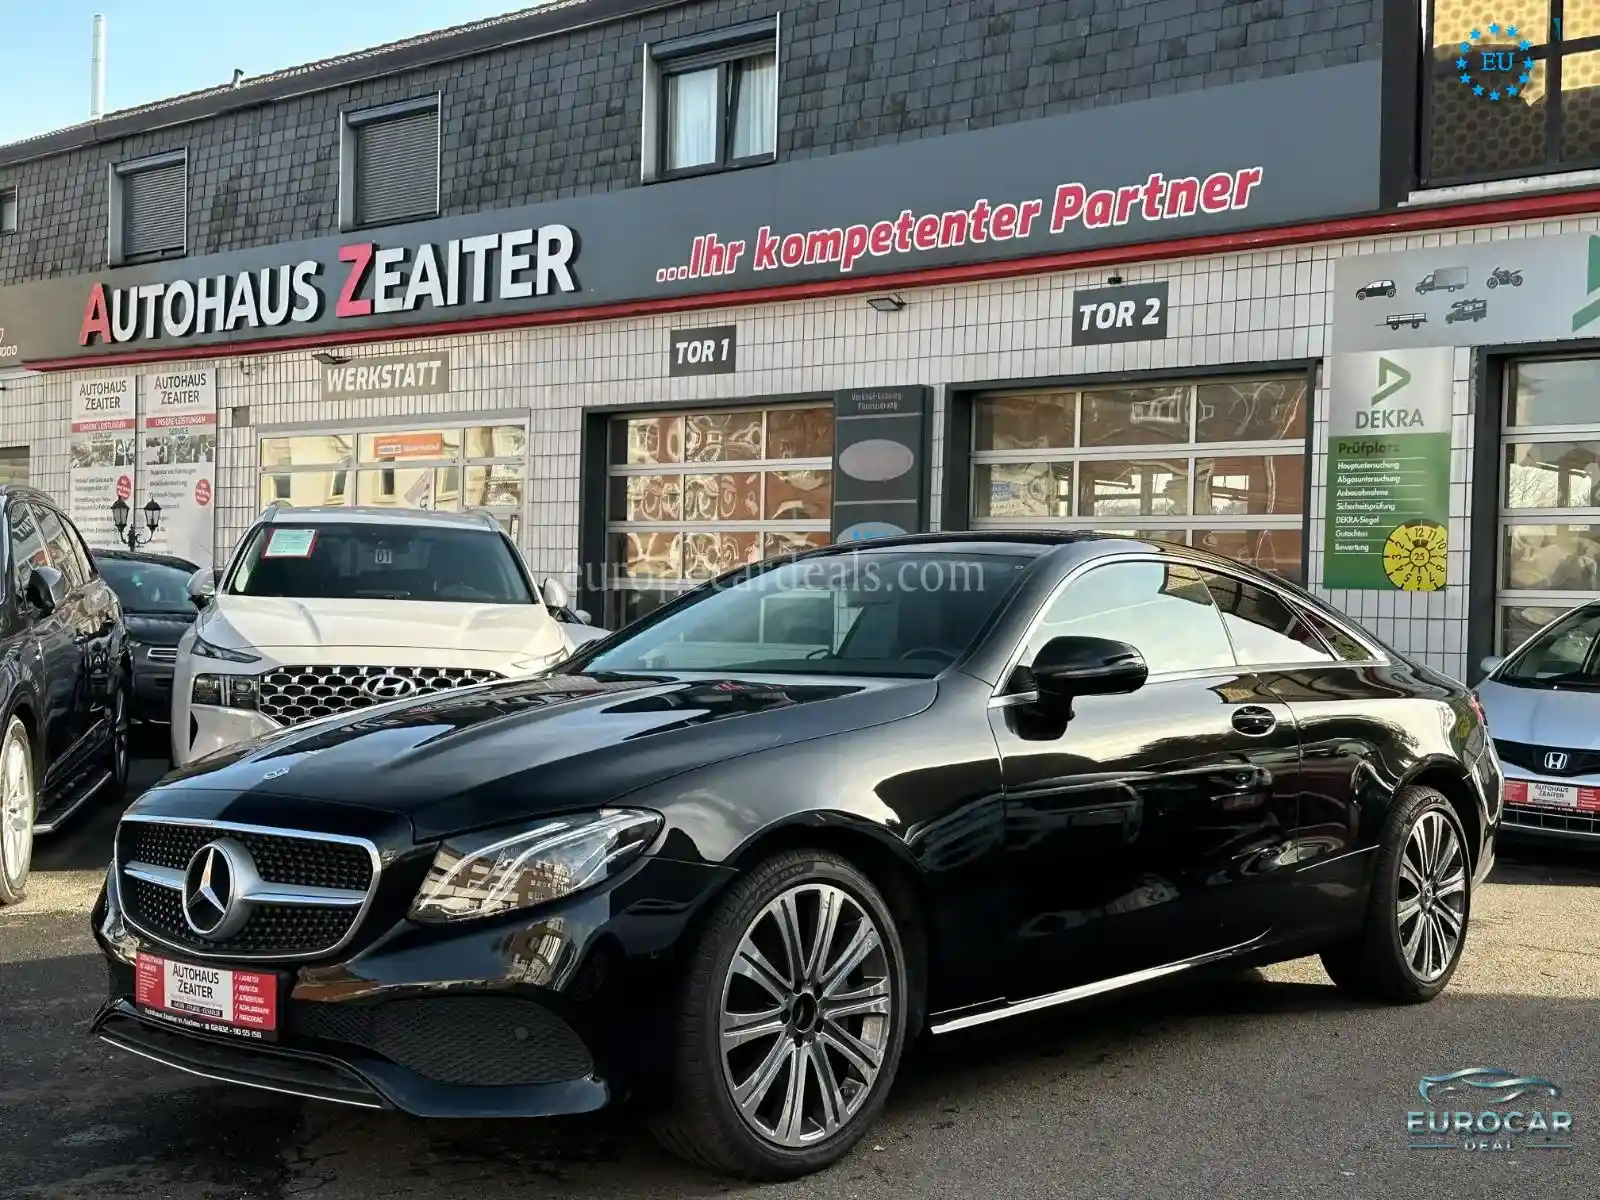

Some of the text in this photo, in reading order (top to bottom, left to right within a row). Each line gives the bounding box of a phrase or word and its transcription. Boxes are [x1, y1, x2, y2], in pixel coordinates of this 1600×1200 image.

[753, 197, 1042, 272] kompetenter
[1050, 166, 1264, 233] Partner
[79, 223, 578, 345] AUTOHAUS ZEAITER
[1079, 297, 1161, 331] TOR 2
[674, 338, 730, 365] TOR 1
[155, 373, 207, 390] AUTOHAUS
[326, 359, 443, 394] WERKSTATT
[80, 380, 127, 396] AUTOHAUS
[85, 397, 121, 411] ZEAITER
[160, 390, 200, 405] ZEAITER
[1355, 408, 1424, 429] DEKRA
[1338, 441, 1400, 456] Prüfplatz
[1337, 460, 1400, 470] Hauptuntersuchung
[1337, 475, 1401, 484] Abgasuntersuchung
[1336, 488, 1389, 497] Anbauabnahme
[1336, 501, 1396, 512] Sicherheitsprüfung
[1335, 516, 1380, 526] DEKRA-Siegel
[1335, 529, 1369, 538] Gutachten
[1415, 527, 1424, 538] 12
[1334, 543, 1369, 552] Bewertung
[172, 963, 220, 984] AUTOHAUS
[178, 979, 213, 999] ZEAITER
